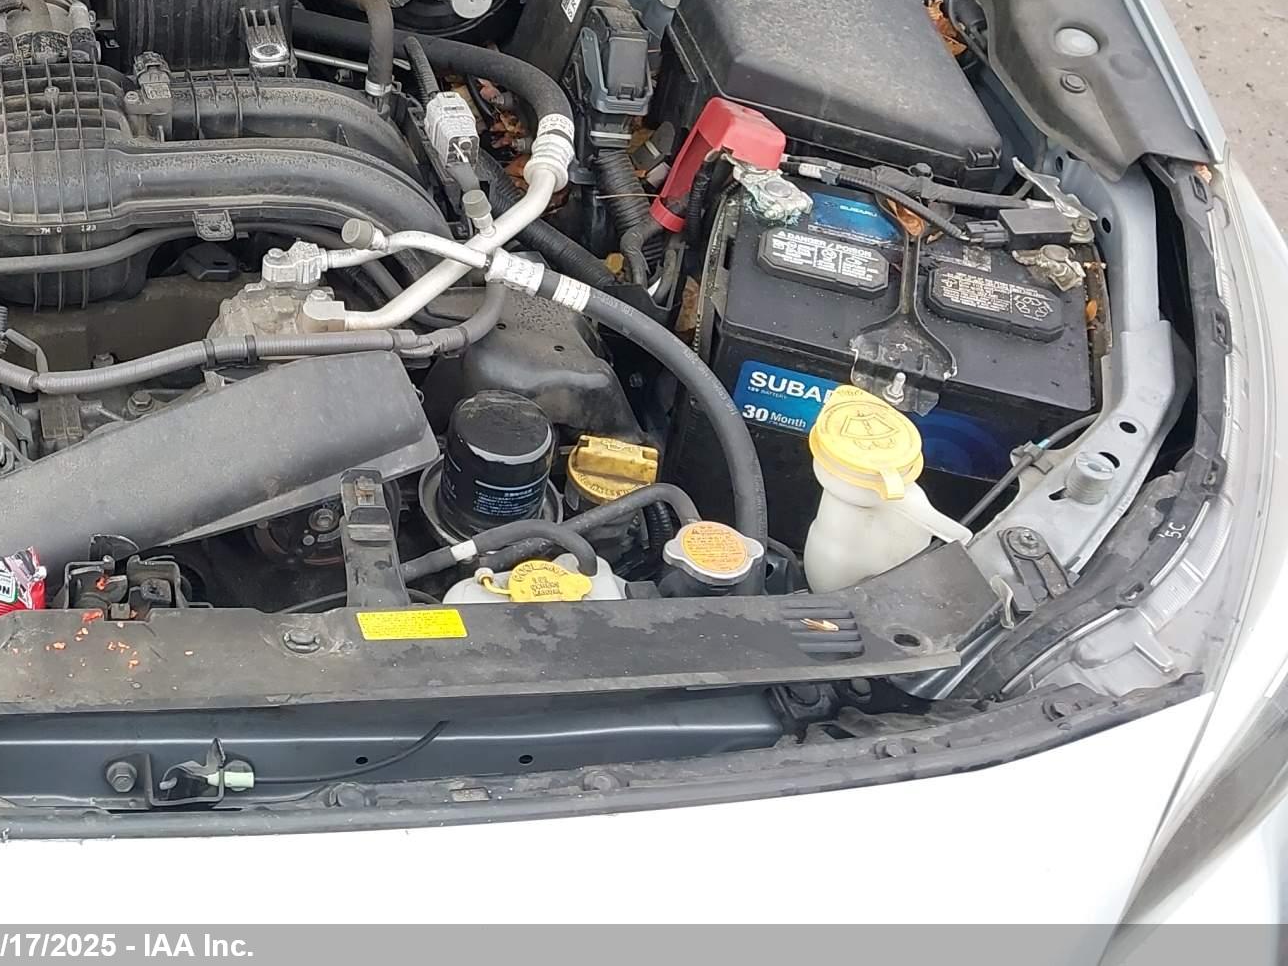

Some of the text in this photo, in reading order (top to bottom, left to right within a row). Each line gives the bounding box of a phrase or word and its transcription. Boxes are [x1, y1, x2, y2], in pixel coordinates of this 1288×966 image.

[839, 204, 878, 217] SUBARU
[787, 232, 827, 248] DANGER
[835, 243, 873, 258] POISON
[742, 404, 769, 422] 30
[770, 411, 807, 429] Month
